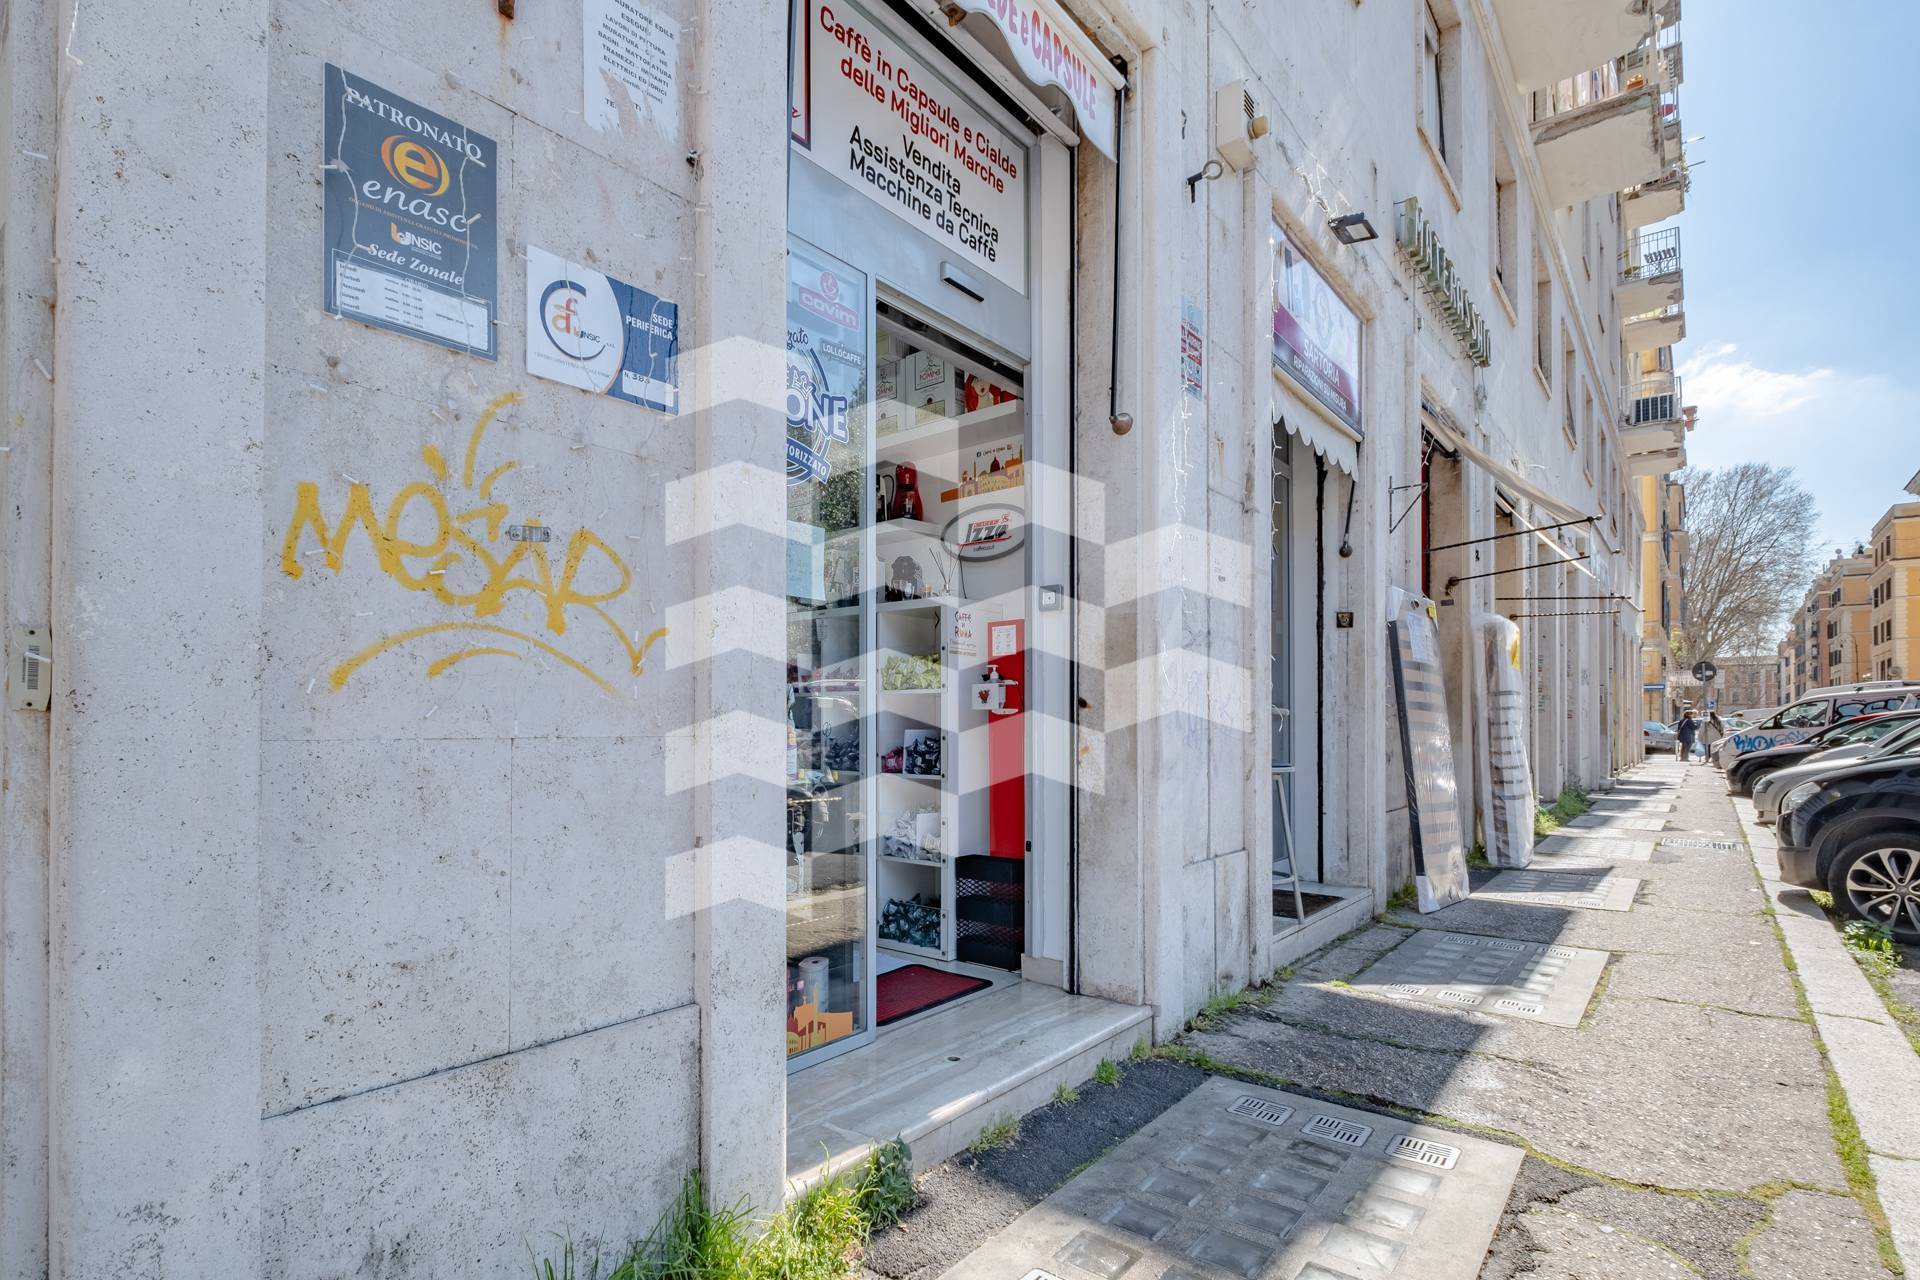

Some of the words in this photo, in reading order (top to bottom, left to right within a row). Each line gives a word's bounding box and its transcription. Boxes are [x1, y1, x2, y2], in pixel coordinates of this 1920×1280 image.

[598, 30, 619, 47] BAGNI
[602, 23, 639, 49] MURATURA
[605, 13, 630, 33] LAVORI
[631, 30, 638, 38] DI
[655, 23, 674, 40] EDILE
[602, 43, 635, 67] TRAMEZZI
[603, 55, 637, 79] ELETTRICI
[638, 75, 647, 84] ED
[1031, 9, 1096, 120] CAPSULE
[820, 6, 872, 63] Caffè
[876, 51, 892, 81] in
[897, 67, 960, 133] Capsule
[963, 126, 972, 142] e
[976, 132, 1017, 180] Cialde
[345, 88, 482, 160] PATRONATO
[841, 57, 886, 103] delle
[891, 90, 950, 152] Migliori
[954, 140, 1004, 194] Marche
[850, 125, 943, 206] Assistenza
[946, 191, 999, 243] Tecnica
[902, 134, 961, 195] Vendita
[850, 149, 931, 220] Macchine
[936, 211, 954, 236] da
[959, 223, 996, 263] Caffè
[367, 243, 406, 267] Sede
[410, 256, 464, 285] Zonale
[626, 314, 673, 340] PERIFERICA
[652, 313, 673, 329] SEDE
[1303, 338, 1340, 387] SARTORIA
